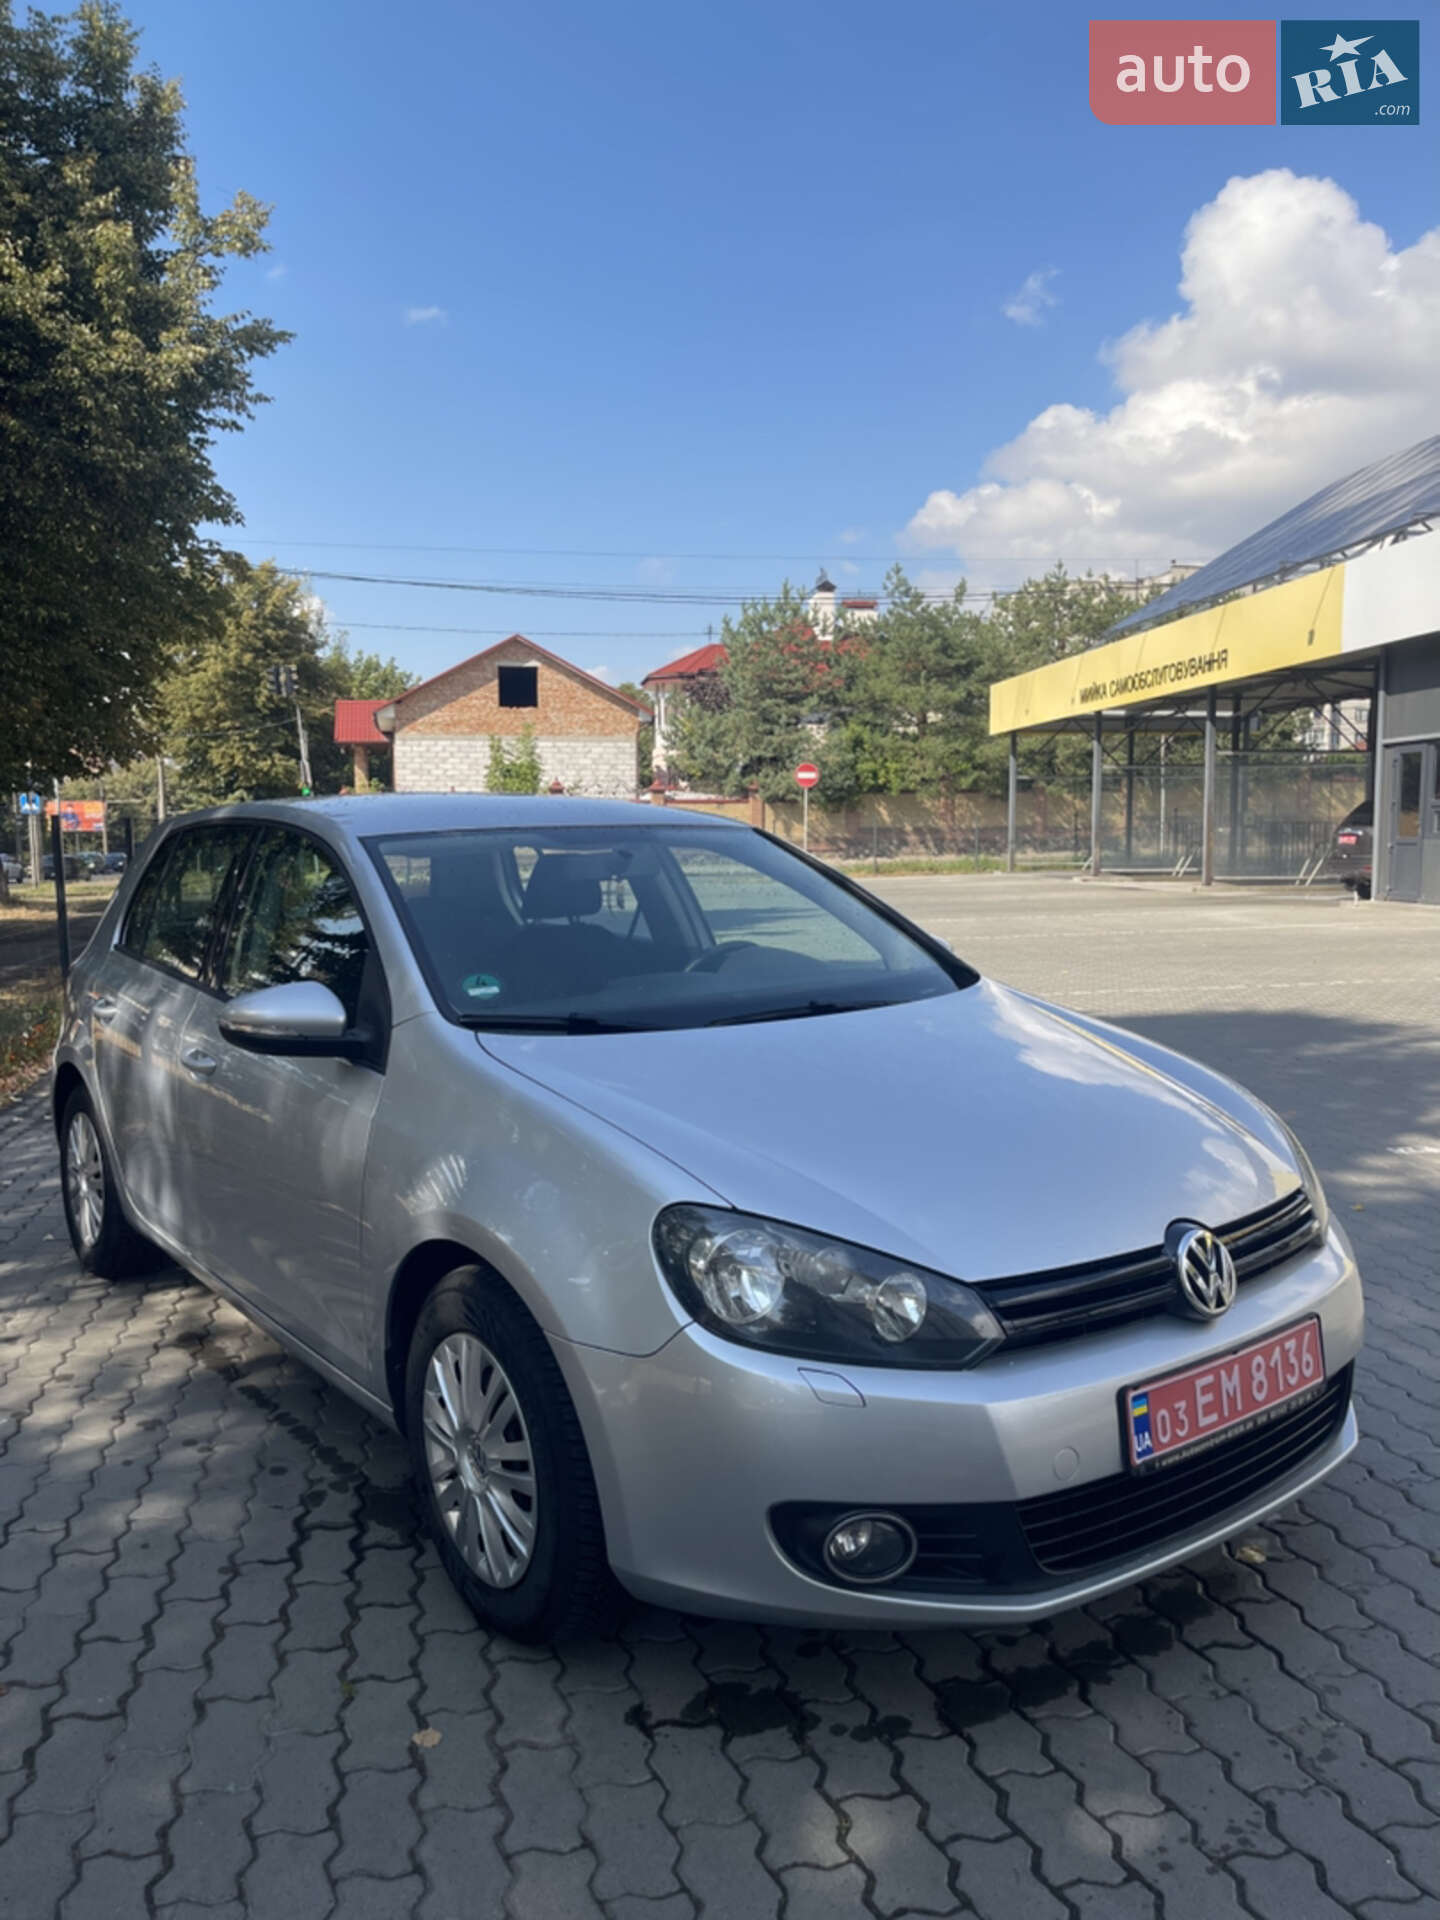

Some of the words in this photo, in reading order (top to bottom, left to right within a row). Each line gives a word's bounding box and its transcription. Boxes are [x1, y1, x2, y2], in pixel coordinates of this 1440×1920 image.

[1156, 1400, 1189, 1444] 03
[1194, 1364, 1243, 1429] EM
[1250, 1331, 1315, 1402] 8136
[1134, 1432, 1153, 1452] UA
